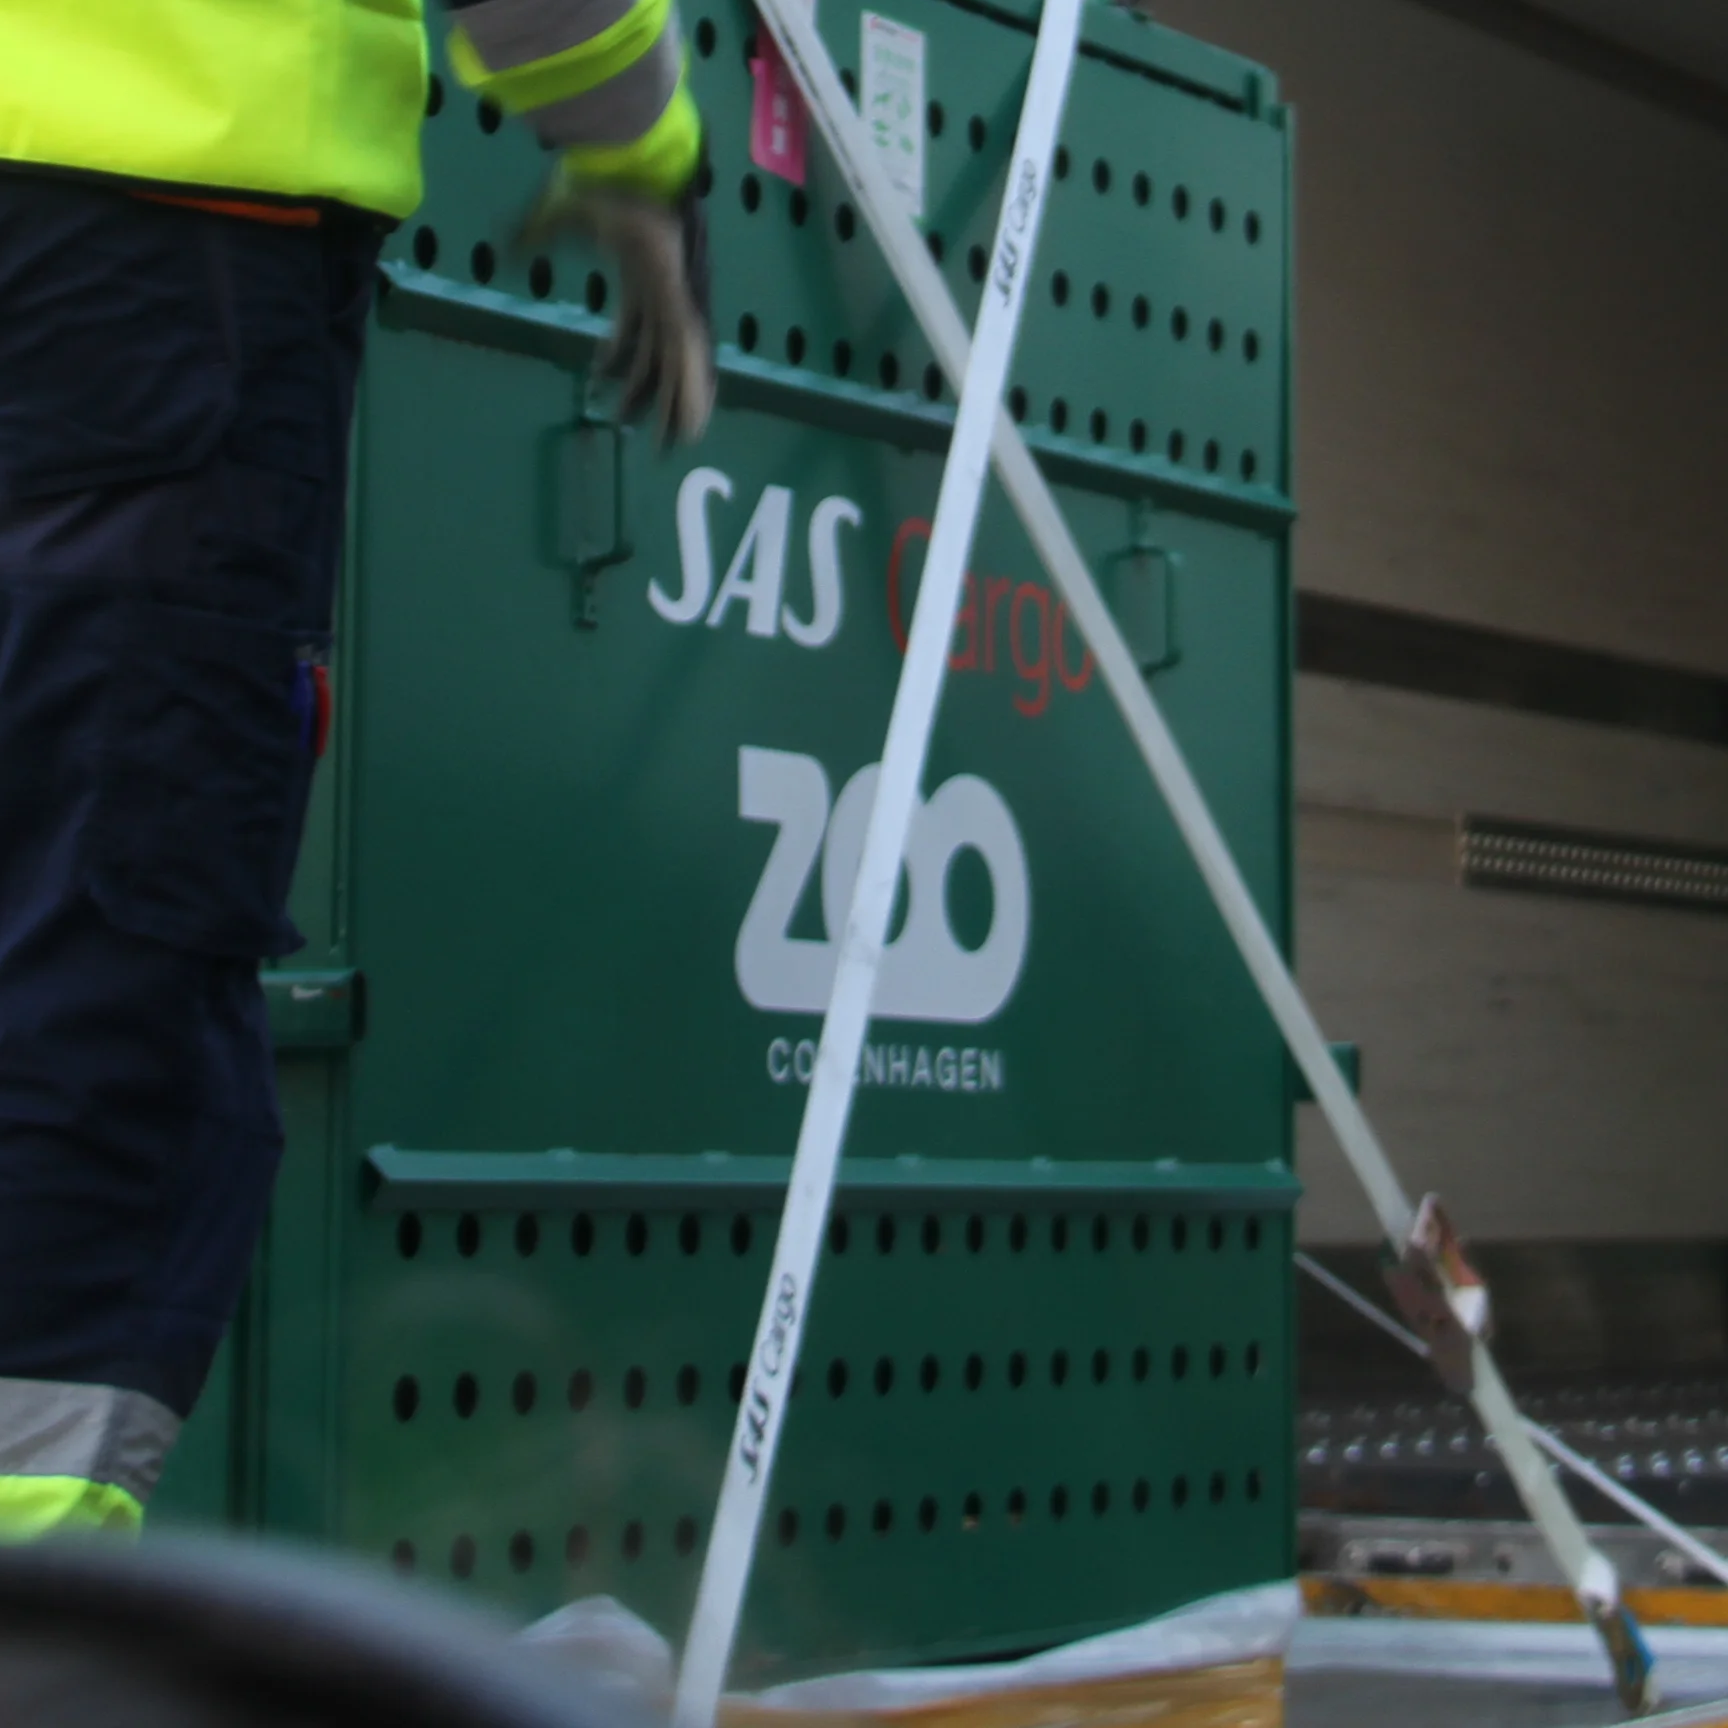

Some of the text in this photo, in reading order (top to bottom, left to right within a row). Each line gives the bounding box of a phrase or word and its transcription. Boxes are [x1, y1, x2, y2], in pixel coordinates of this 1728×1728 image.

[647, 466, 862, 648] SAS
[734, 744, 1031, 1025] ZOO
[766, 1037, 1004, 1092] CONHAGEN
